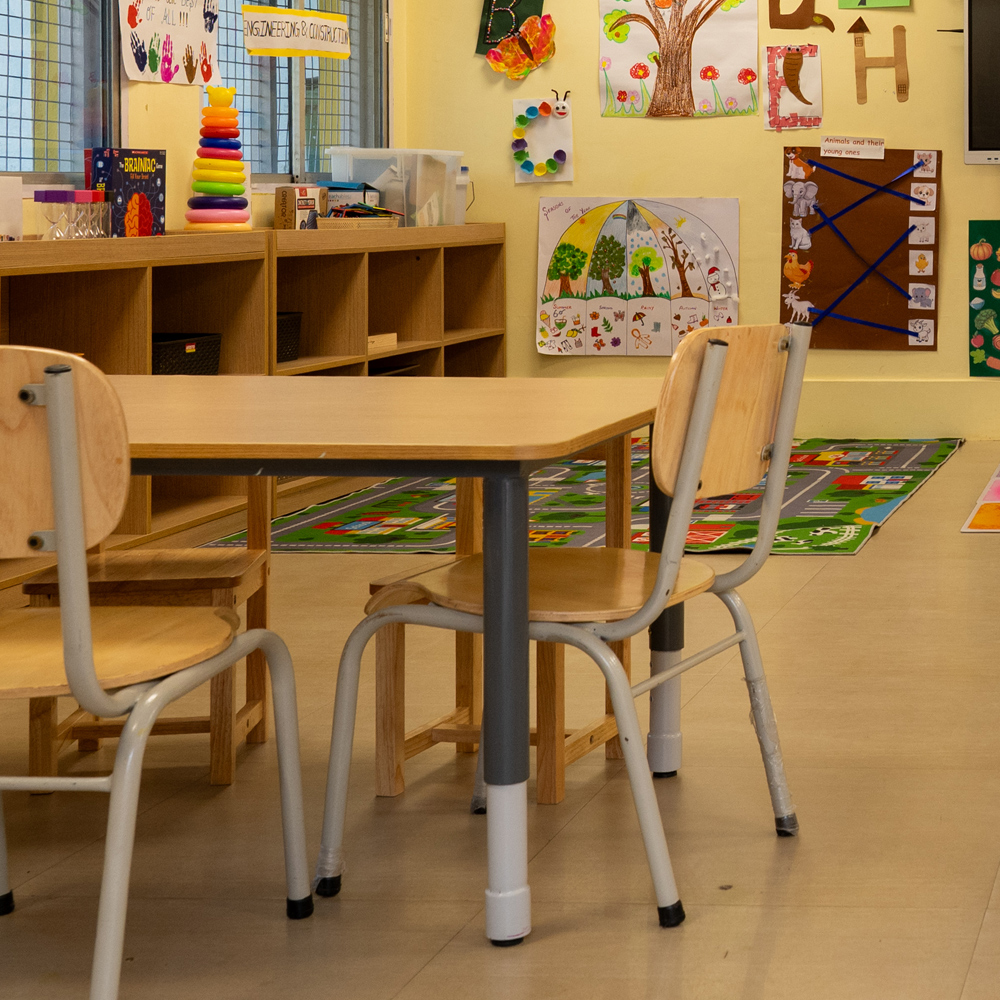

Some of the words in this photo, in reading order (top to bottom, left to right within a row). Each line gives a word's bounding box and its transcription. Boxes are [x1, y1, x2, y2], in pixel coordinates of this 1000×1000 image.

[146, 6, 155, 21] OF
[161, 8, 176, 26] ALL
[244, 20, 300, 38] ENGINEERING
[301, 20, 308, 37] &
[848, 17, 909, 105] H
[766, 44, 822, 130] E
[511, 100, 568, 176] C
[825, 137, 850, 145] Animals
[124, 157, 156, 172] BRAINIAC
